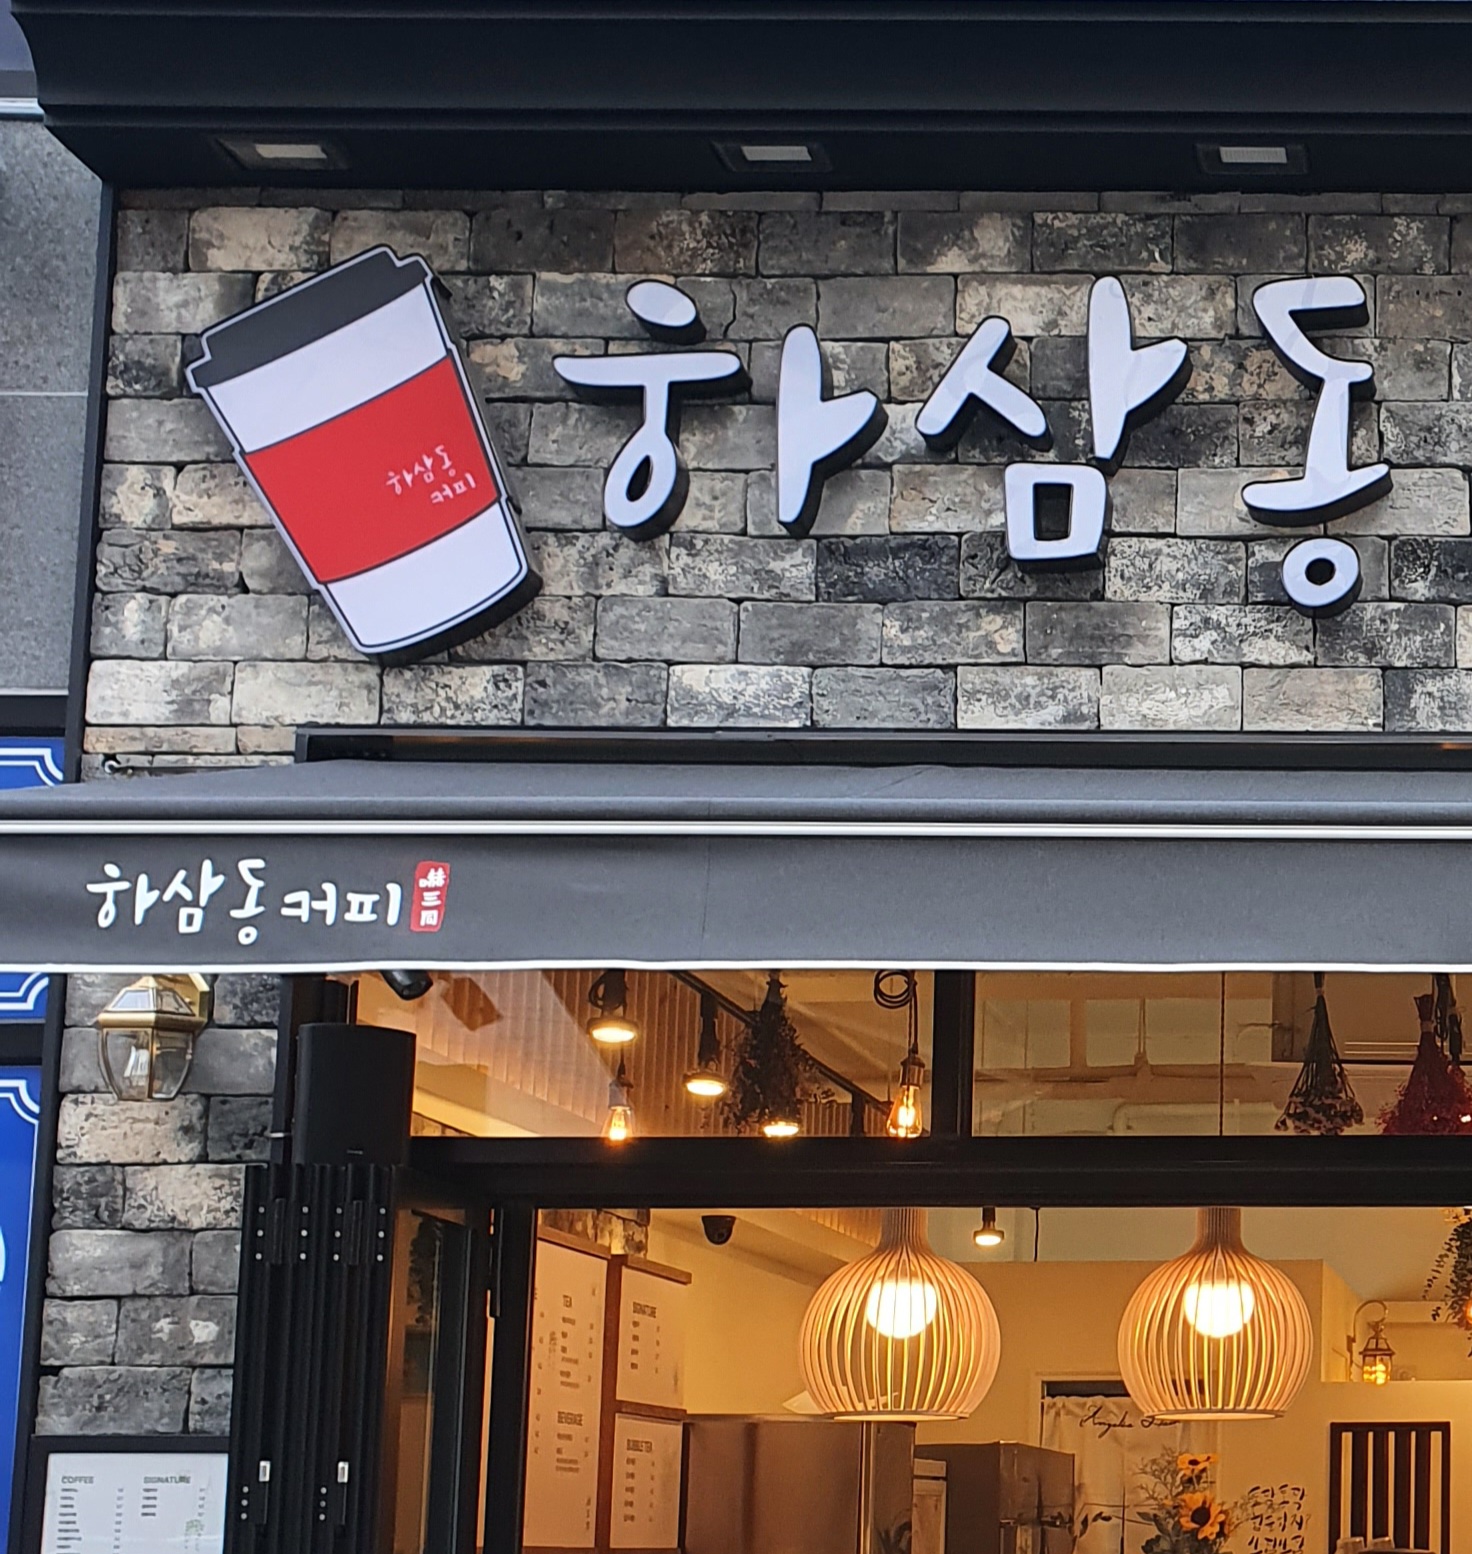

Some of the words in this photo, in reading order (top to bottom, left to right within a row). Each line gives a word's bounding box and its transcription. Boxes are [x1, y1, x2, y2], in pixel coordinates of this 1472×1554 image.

[552, 273, 1394, 612] 하삼동
[386, 444, 457, 496] 하삼동
[430, 471, 477, 504] 커피
[86, 858, 267, 946] 하삼동
[280, 881, 402, 927] 커피
[61, 1476, 94, 1484] COFFEE
[143, 1475, 191, 1484] SIGNATURE
